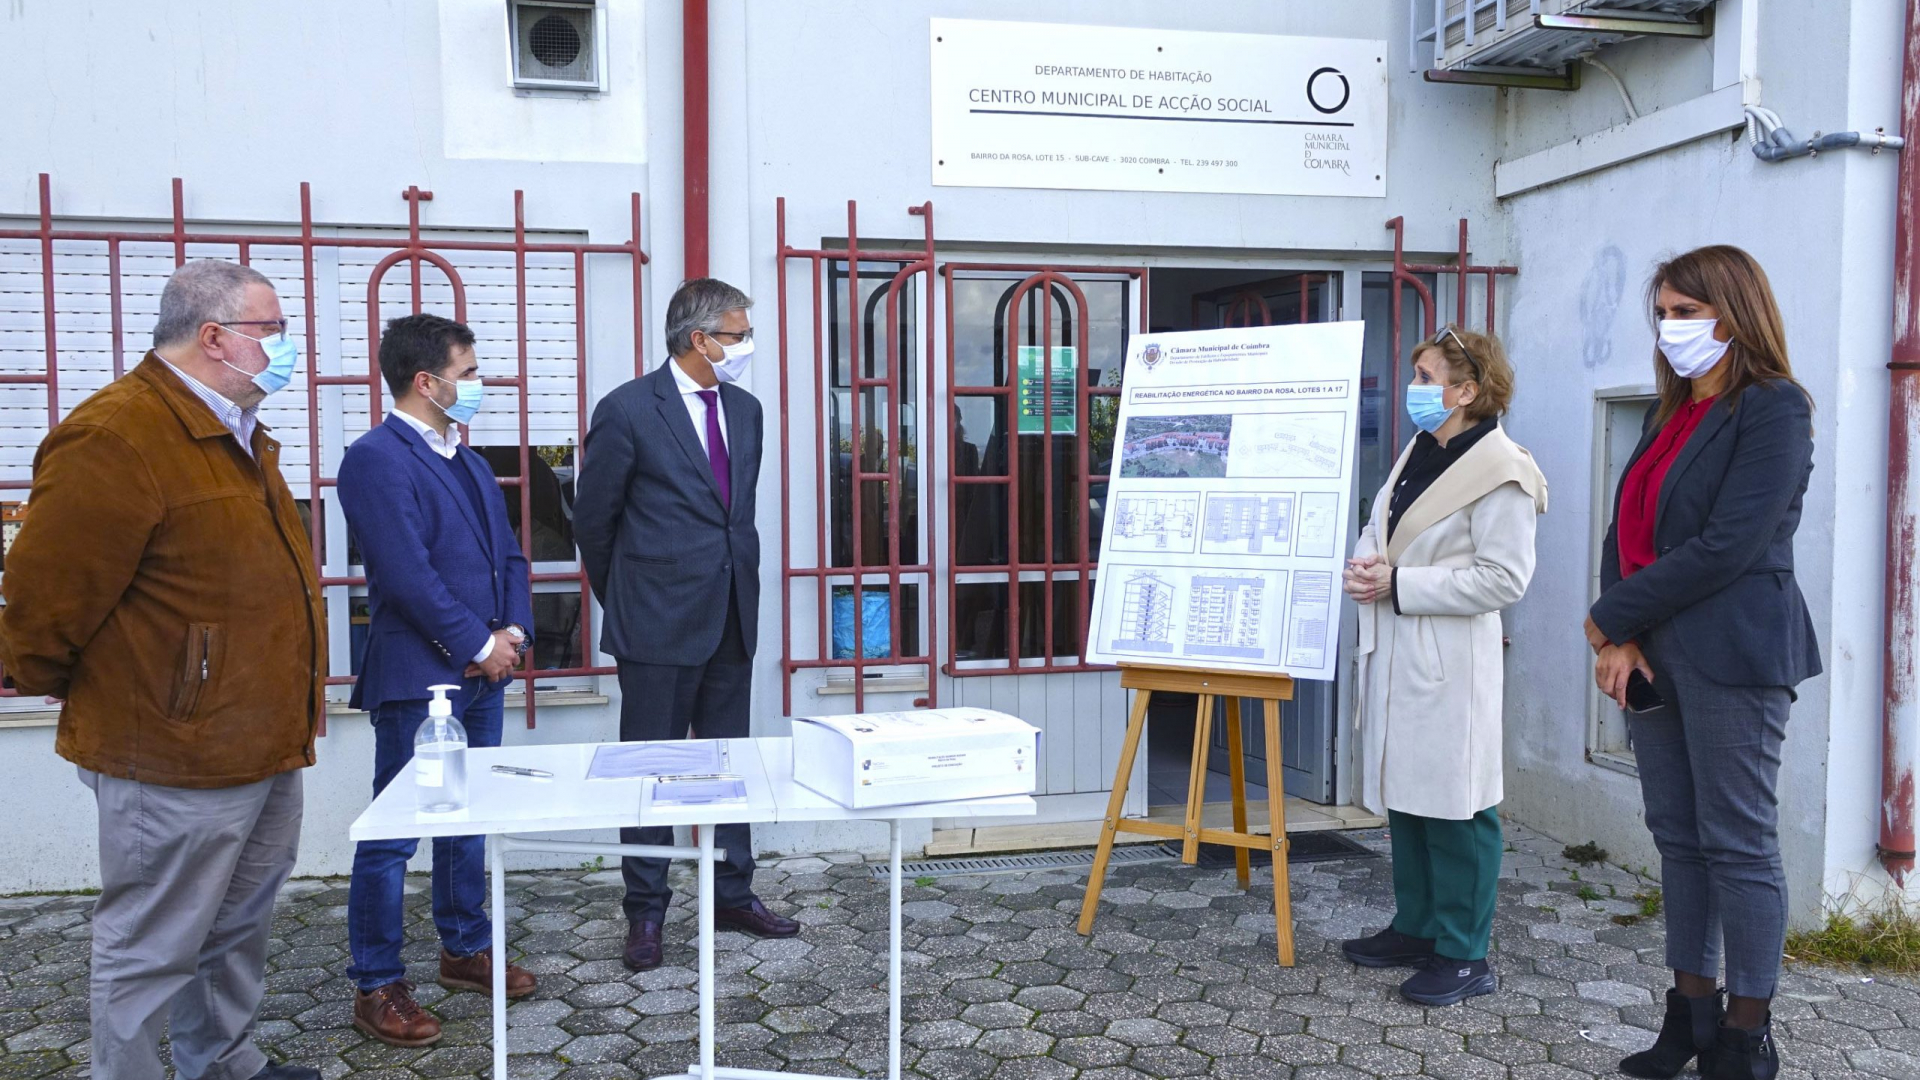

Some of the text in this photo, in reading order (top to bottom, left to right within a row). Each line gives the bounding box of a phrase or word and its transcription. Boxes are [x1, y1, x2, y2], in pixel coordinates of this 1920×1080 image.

[1035, 65, 1212, 84] DEPARTAMENTO DE HABITAÇÃO
[969, 88, 1272, 113] CENTRO MUNICIPAL DE ACÇÃO SOCIAL
[1304, 142, 1350, 150] MUNICIPAL
[1304, 158, 1351, 176] COIMBRA
[1198, 344, 1230, 352] Municipal
[1182, 389, 1224, 397] ENERGÉTICA
